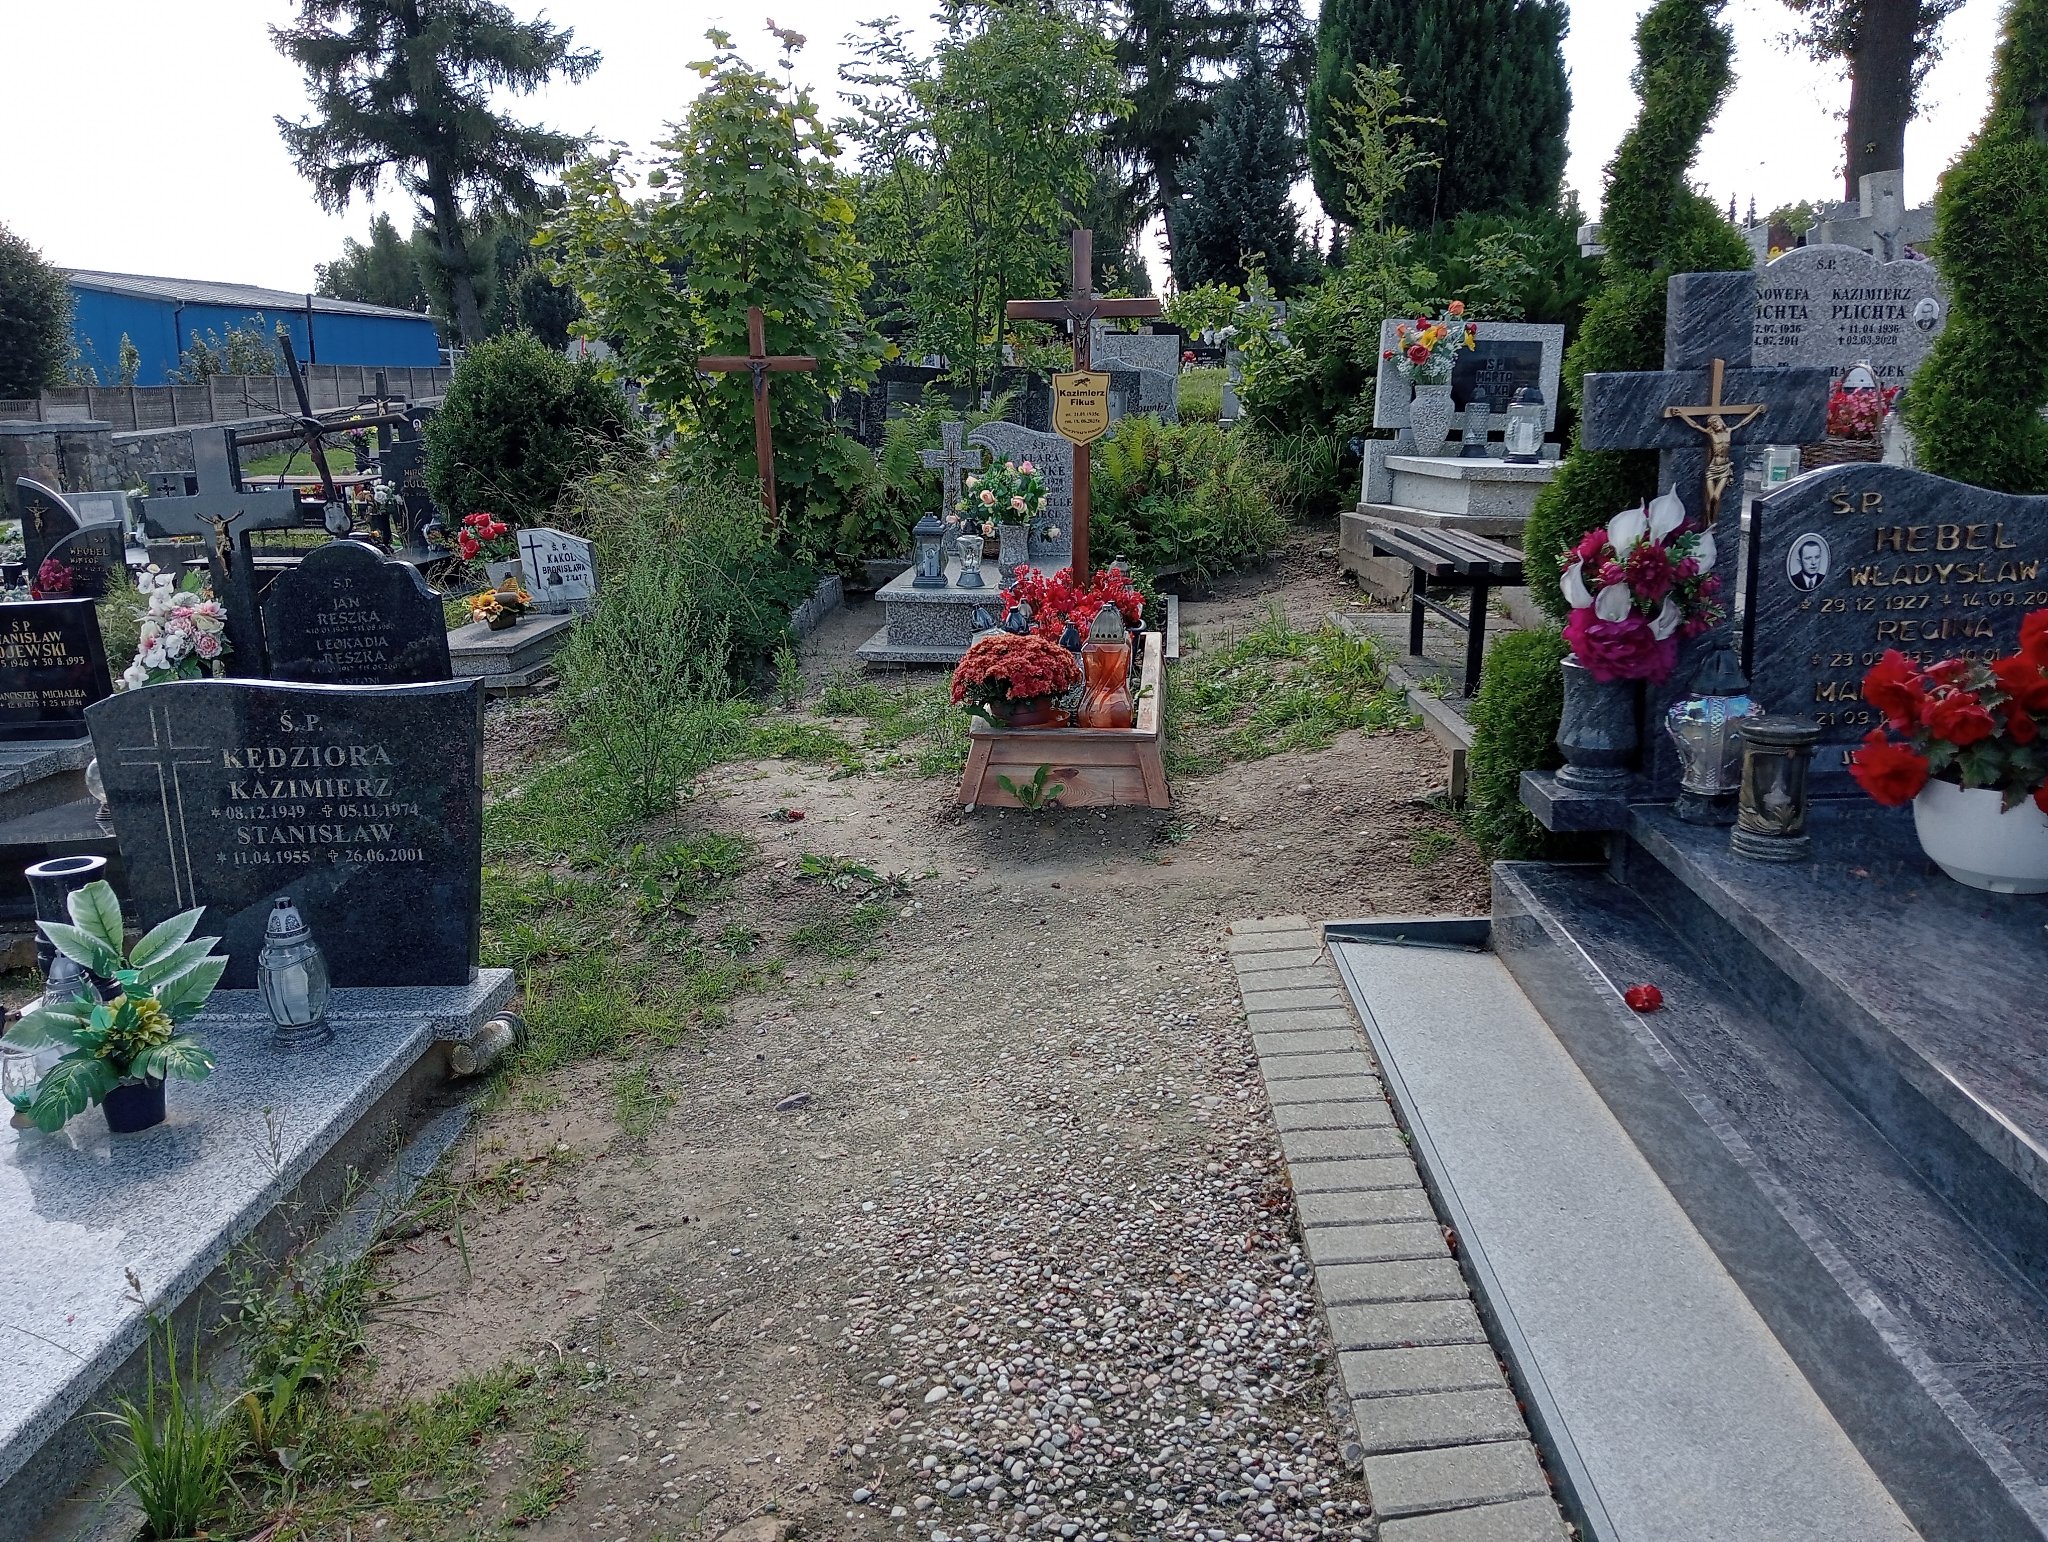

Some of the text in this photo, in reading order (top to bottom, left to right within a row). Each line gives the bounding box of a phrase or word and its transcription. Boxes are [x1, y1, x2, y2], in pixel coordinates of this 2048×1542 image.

[1832, 288, 1912, 300] KAZIMIERZ
[1831, 304, 1907, 320] PLICHTA
[1059, 389, 1105, 397] Kazimierz
[1070, 398, 1096, 406] Fikus
[1021, 453, 1060, 463] KLARA
[1876, 523, 2017, 552] HEBEL
[1851, 560, 2039, 586] WŁADYSŁAW
[333, 598, 360, 610] JAN
[317, 610, 380, 625] RESZKA
[1877, 617, 1994, 641] REGINA
[321, 650, 387, 664] RESZKA
[222, 745, 393, 774] KĘDZIORA
[229, 777, 392, 800] KAZIMIERZ
[225, 803, 419, 820] 08.12.1949 05.11.1974
[237, 823, 393, 845] STANISŁAW
[232, 848, 424, 864] 11.04.1955 26.06.2001
